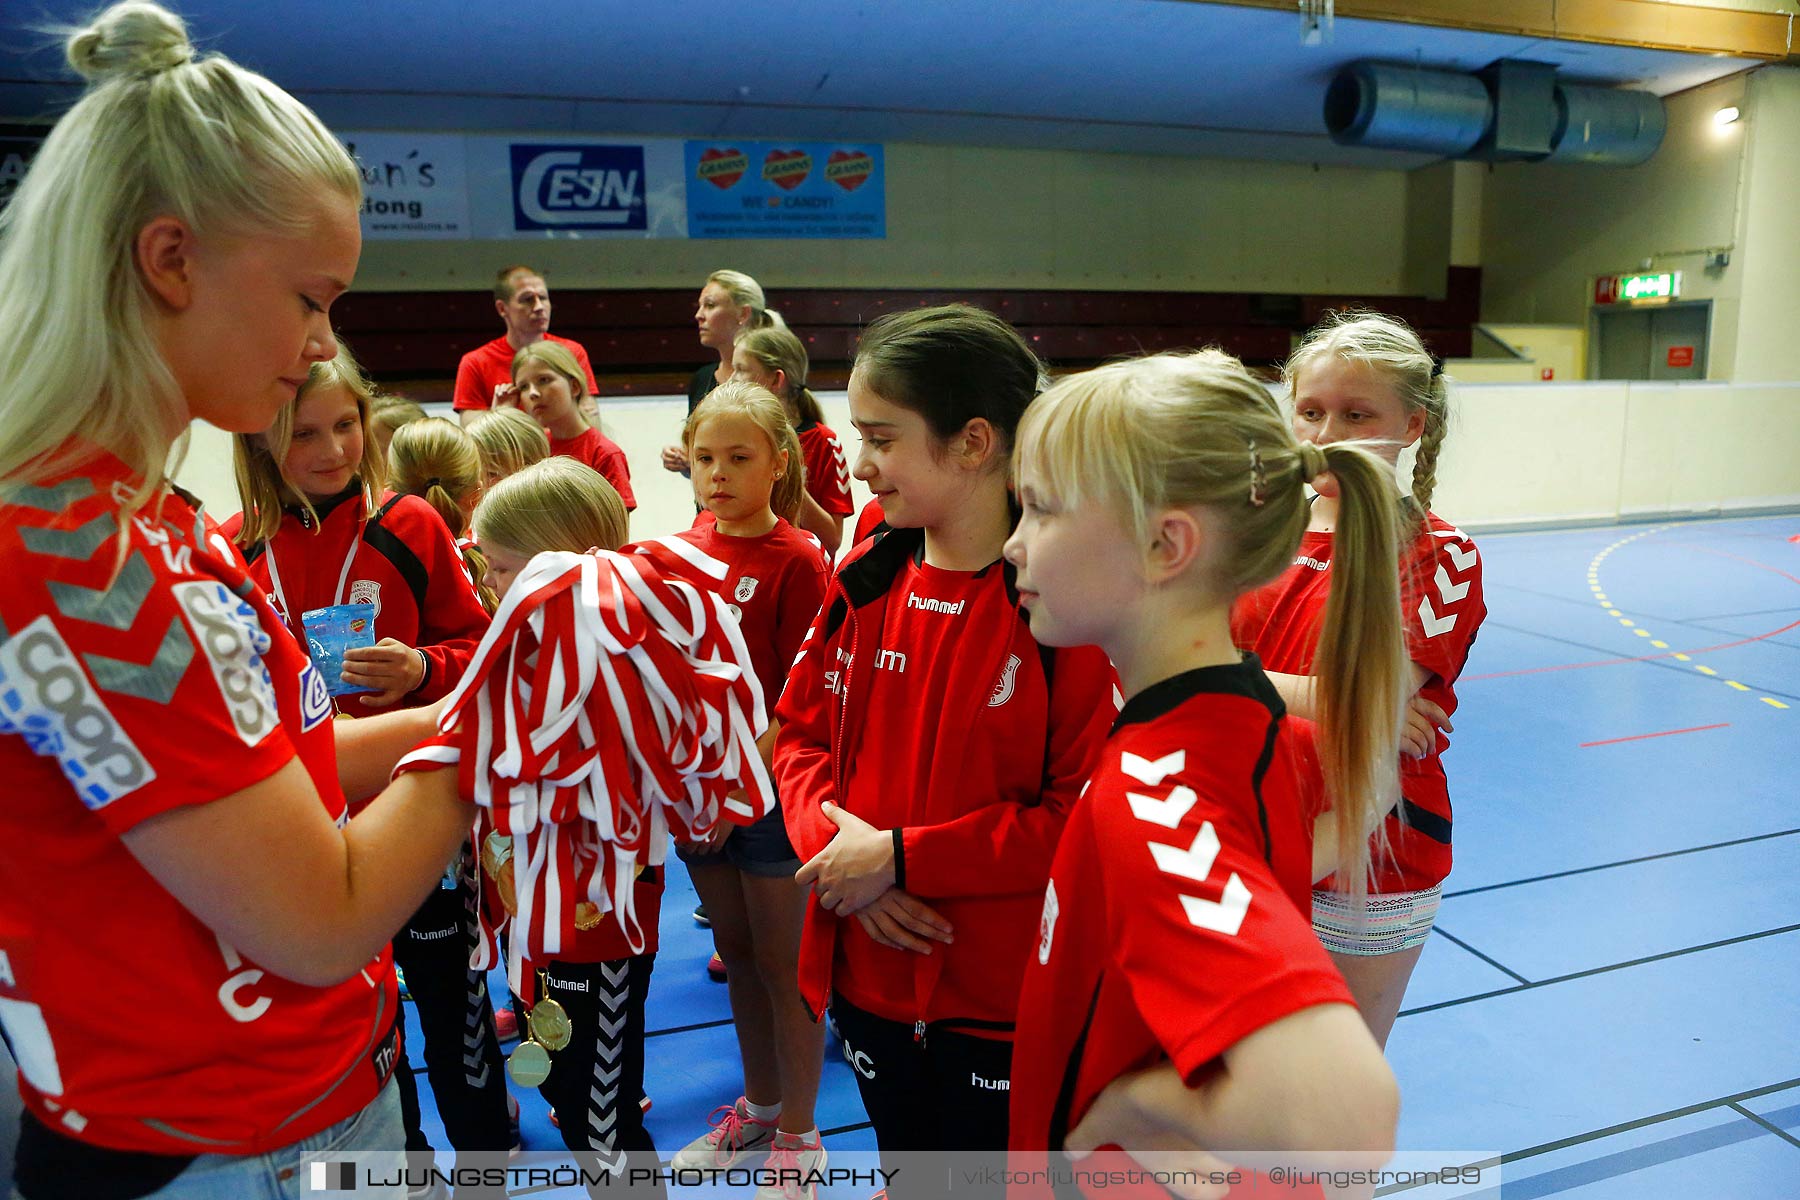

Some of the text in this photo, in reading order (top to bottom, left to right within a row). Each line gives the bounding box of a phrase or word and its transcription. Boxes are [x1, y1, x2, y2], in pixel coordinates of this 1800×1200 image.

[519, 151, 641, 225] CEJN
[907, 591, 965, 615] hummel
[15, 631, 144, 787] coop
[410, 922, 459, 940] hummel
[546, 972, 590, 993] hummel
